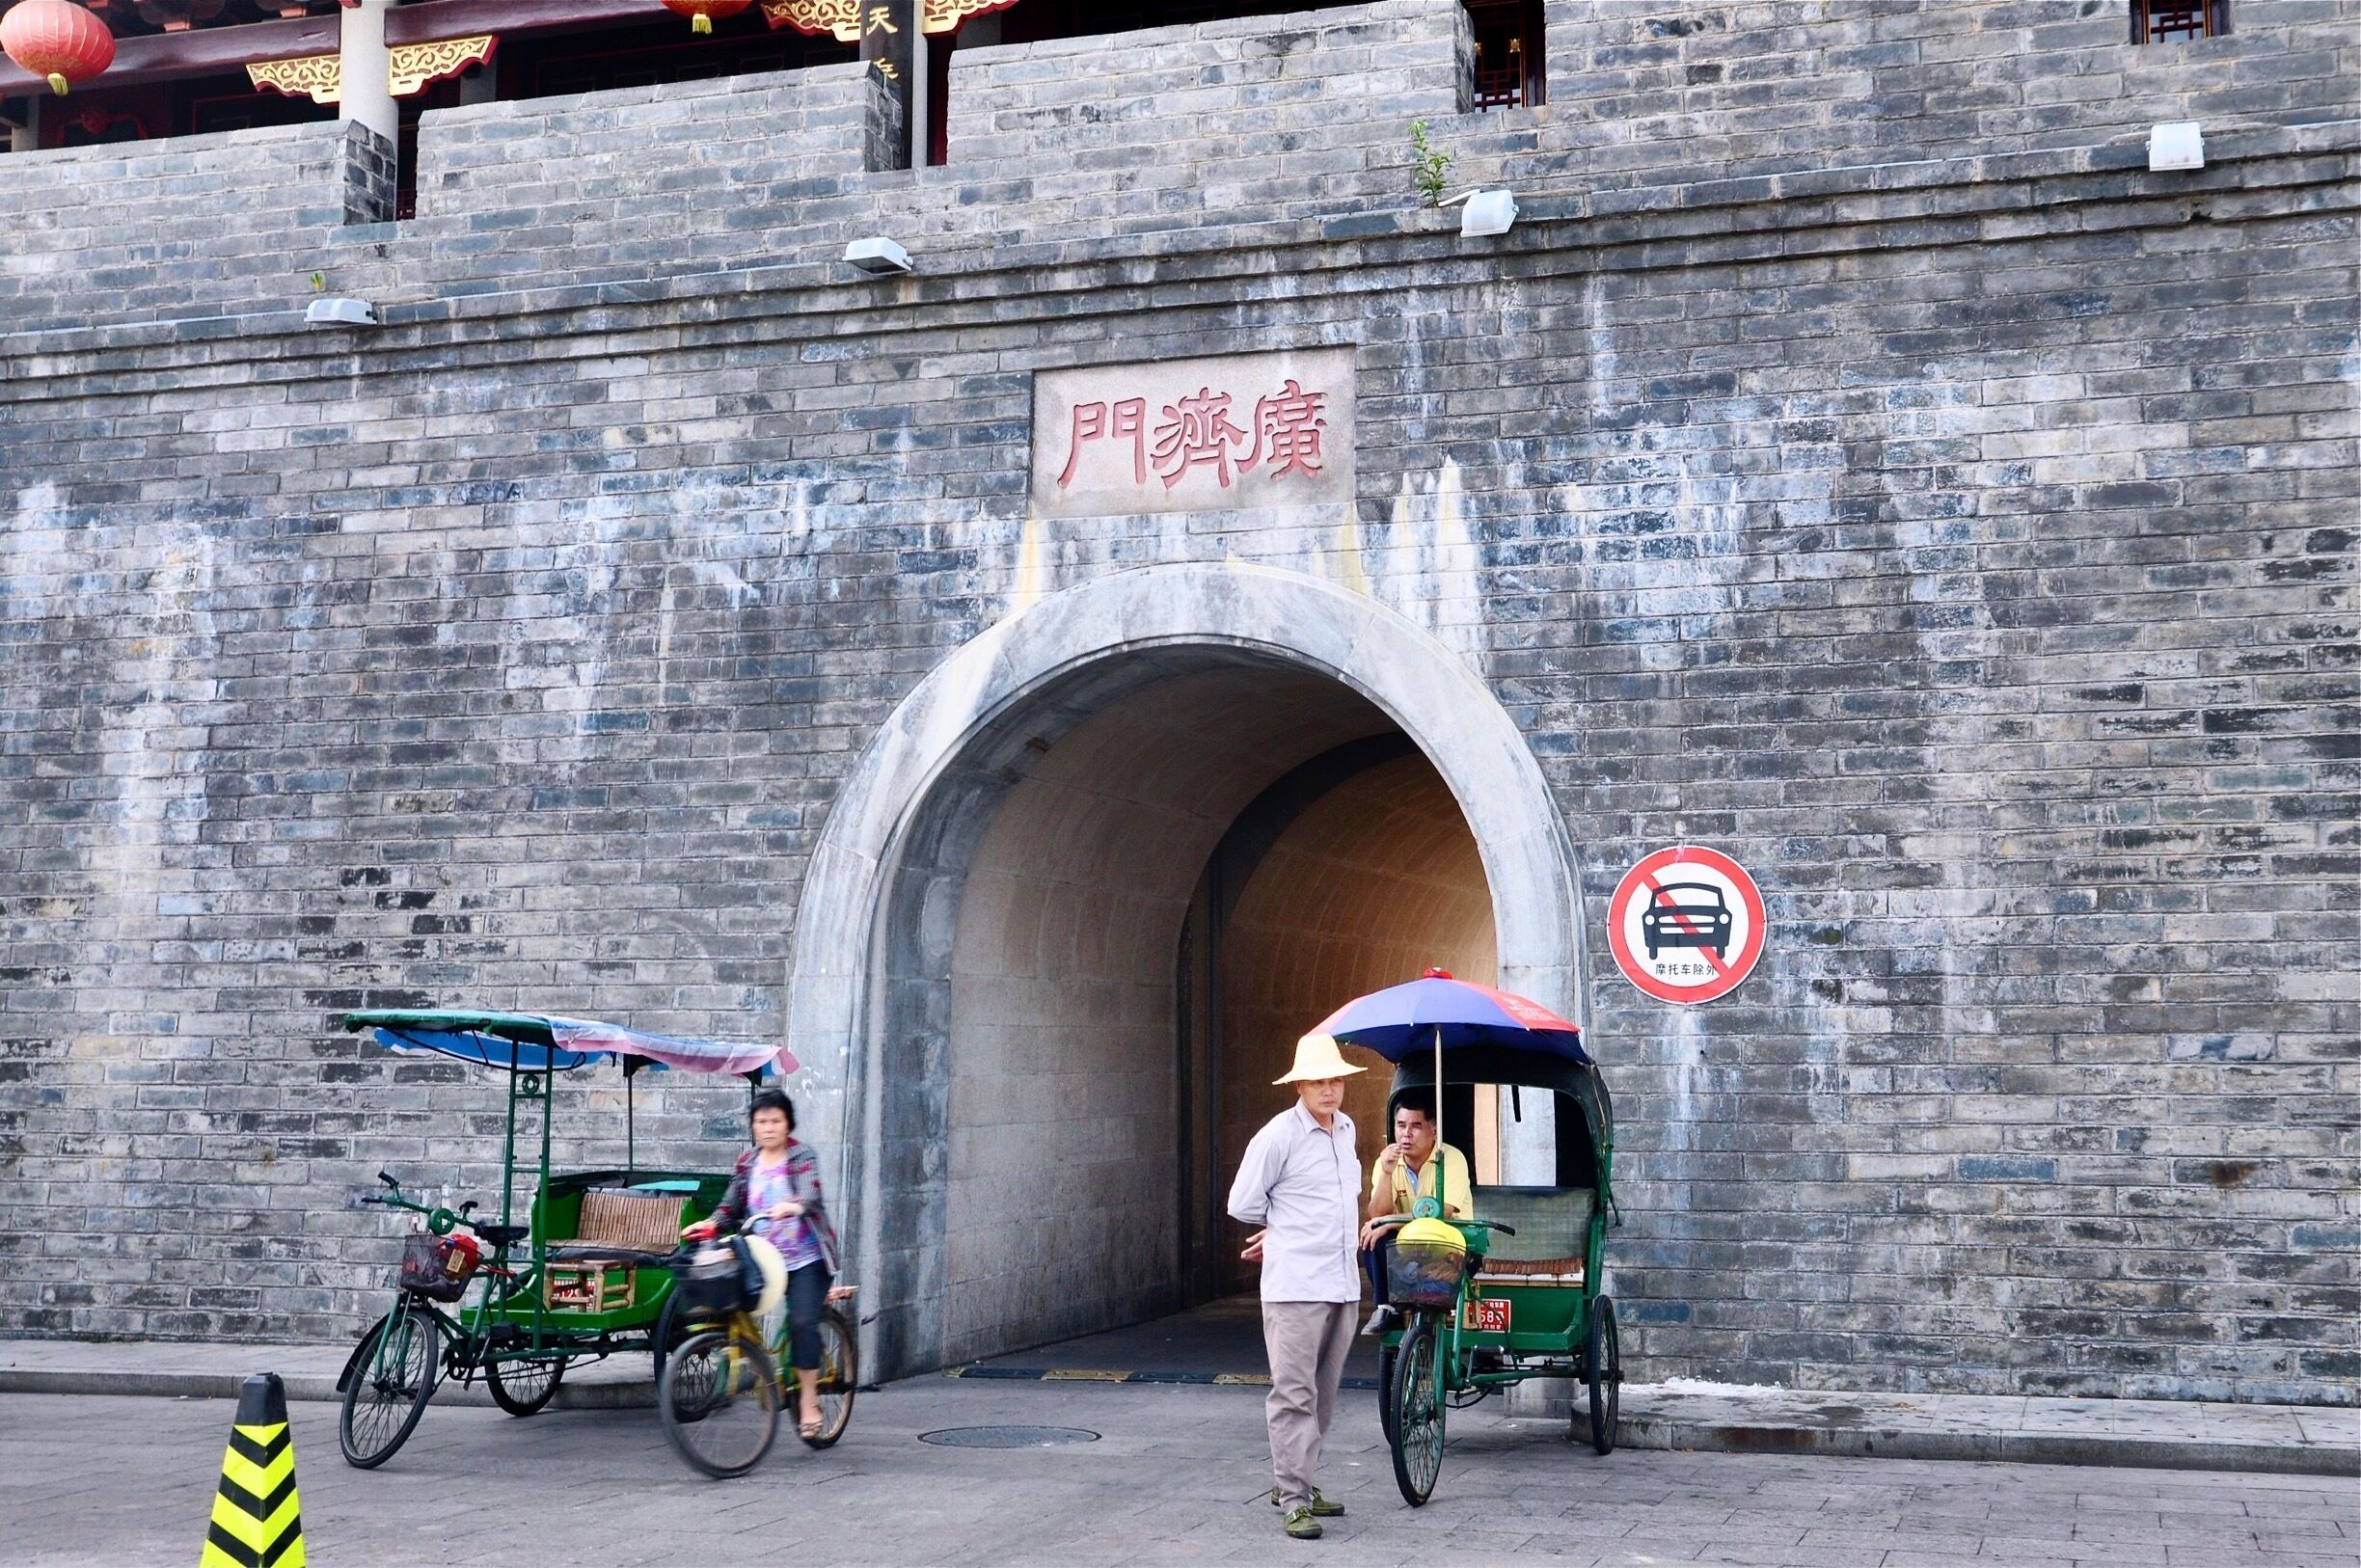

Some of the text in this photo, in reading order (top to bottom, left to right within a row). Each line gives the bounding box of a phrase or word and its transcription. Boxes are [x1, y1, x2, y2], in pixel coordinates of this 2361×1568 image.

[1655, 962, 1717, 976] 摩托车除外
